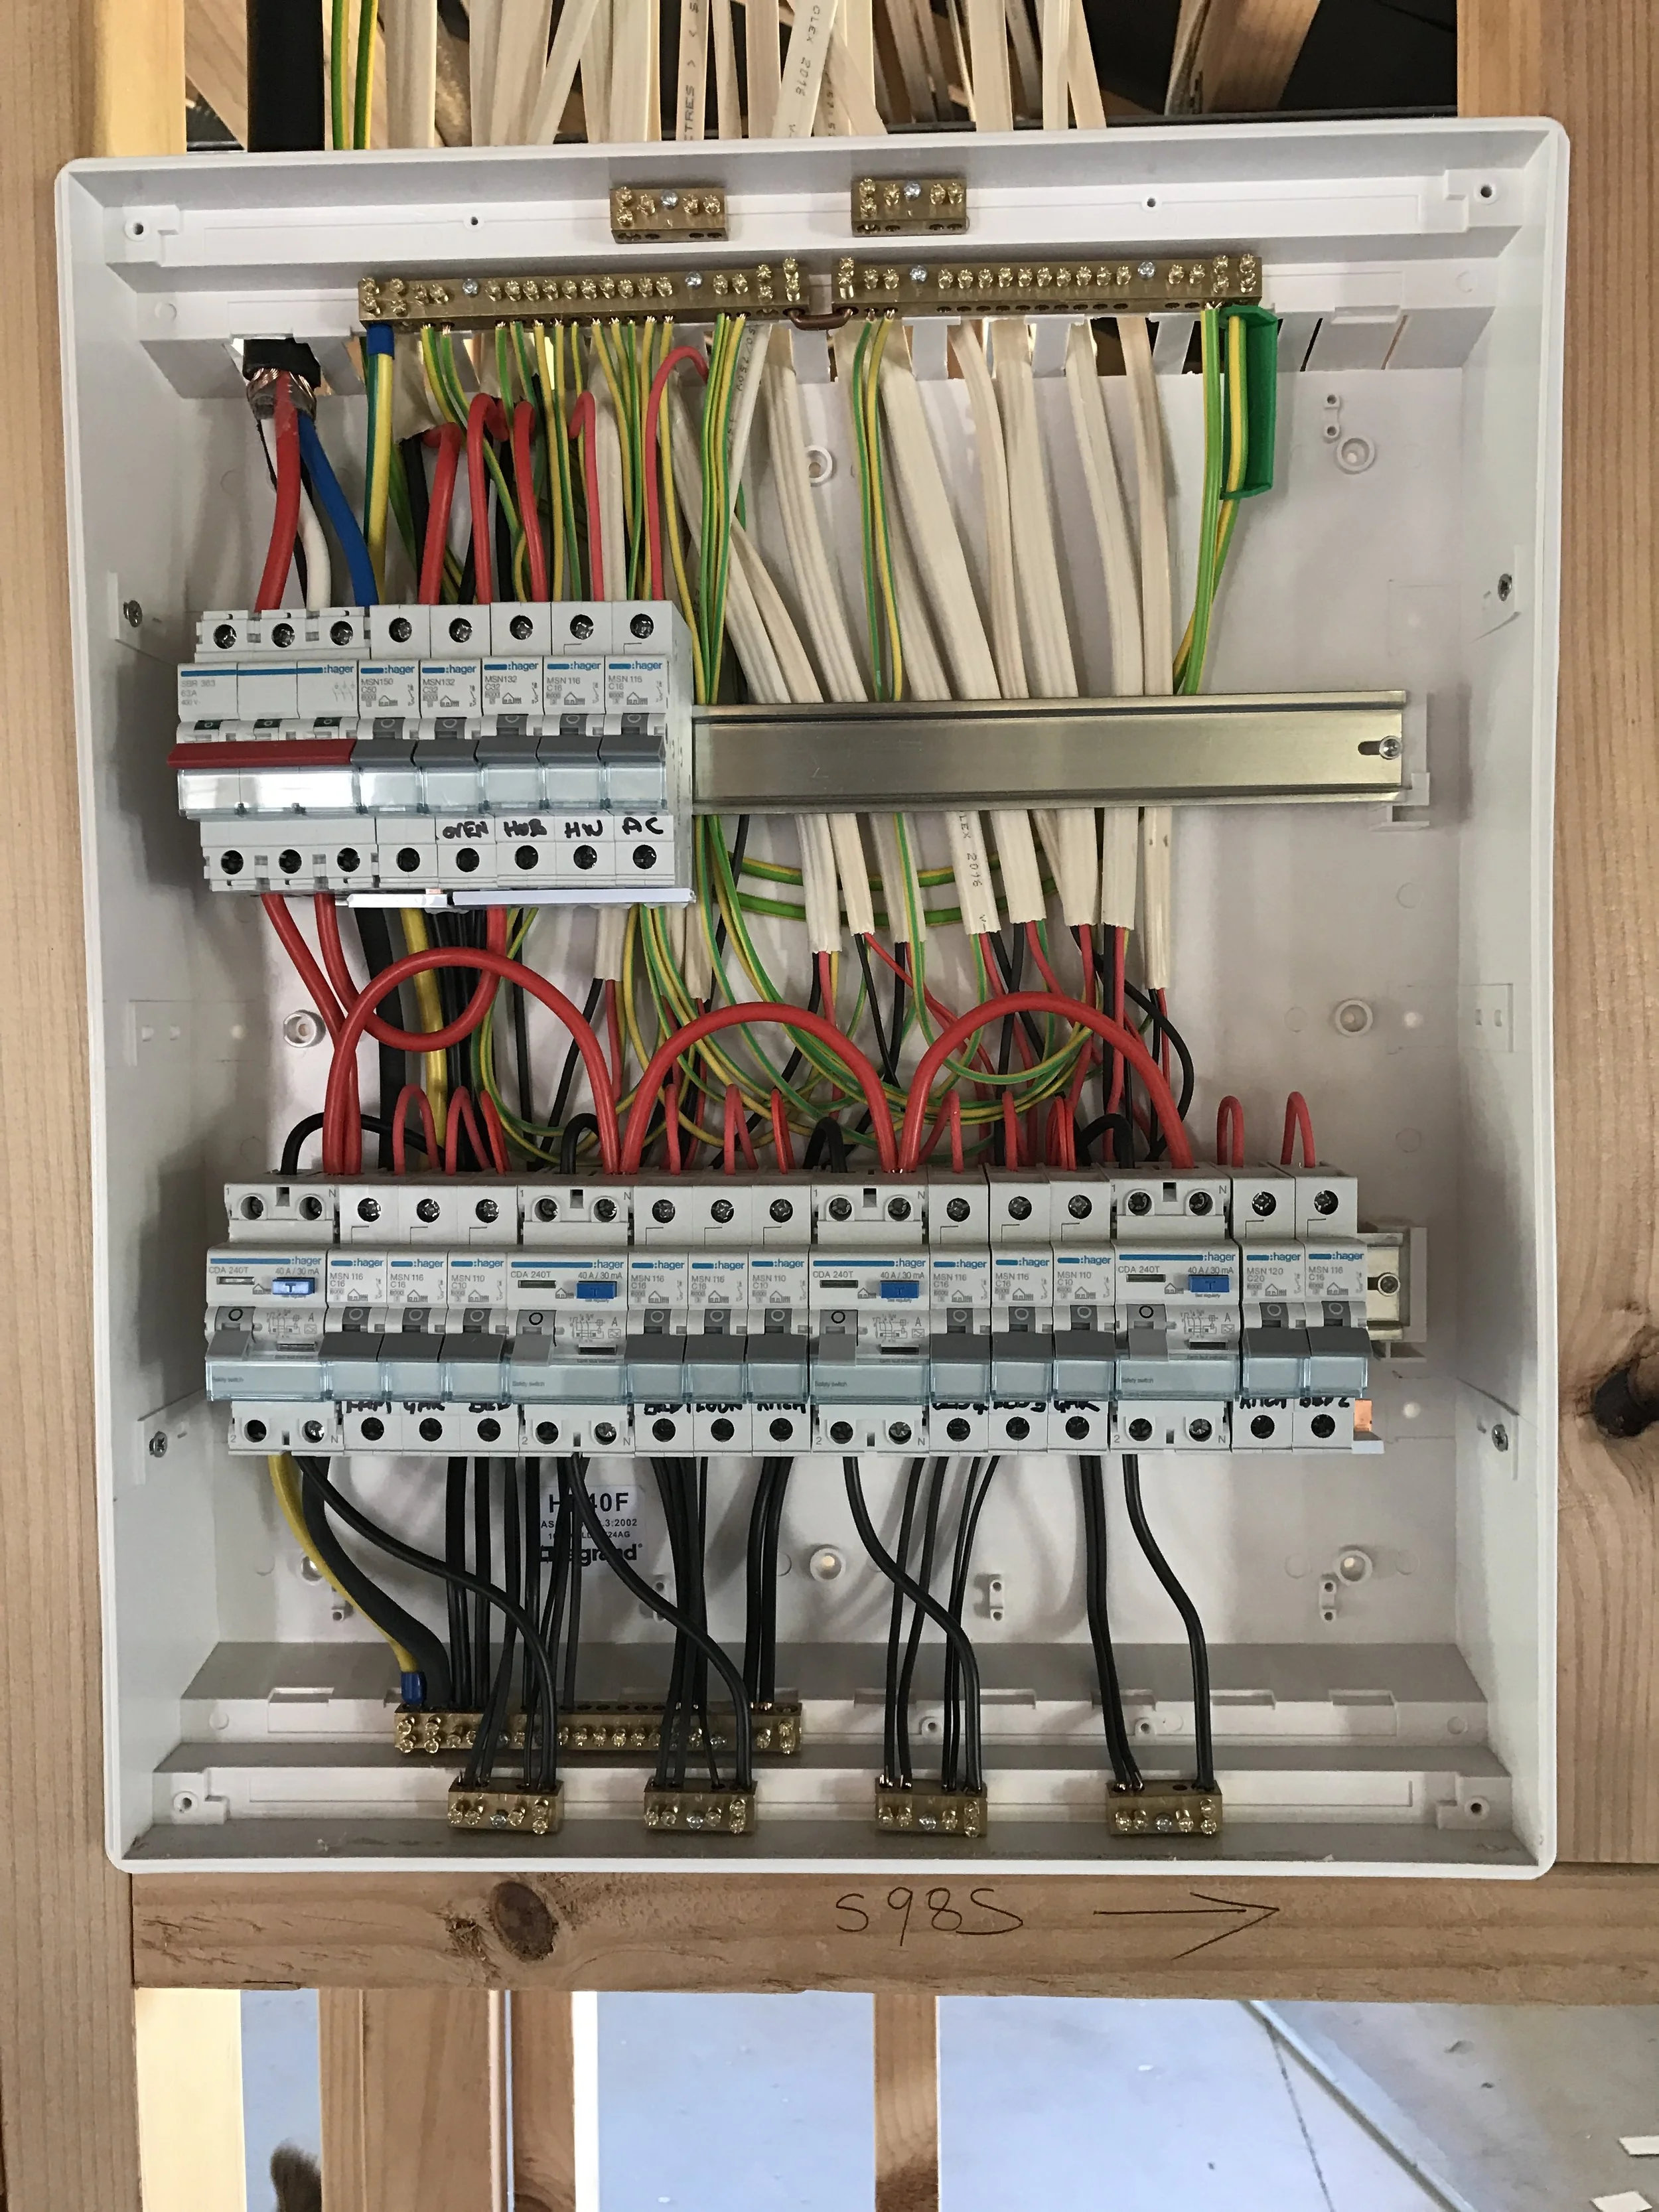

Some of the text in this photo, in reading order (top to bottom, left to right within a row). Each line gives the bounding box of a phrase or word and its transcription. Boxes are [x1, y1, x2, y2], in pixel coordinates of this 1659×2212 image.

[796, 5, 820, 96] OLEX 2016
[442, 820, 489, 839] OVEN
[564, 819, 603, 838] HW
[622, 816, 664, 835] AC
[959, 811, 983, 887] LEX 2016
[328, 1189, 336, 1198] N
[1218, 1185, 1226, 1194] N
[624, 1191, 632, 1200] N
[917, 1191, 925, 1199] N
[285, 1282, 297, 1293] T
[1205, 1280, 1216, 1290] T
[308, 1313, 315, 1322] A
[611, 1317, 618, 1326] A
[914, 1317, 922, 1327] A
[1224, 1313, 1231, 1322] A
[331, 1435, 338, 1443] N
[623, 1438, 631, 1446] N
[816, 1436, 822, 1445] 2
[917, 1438, 925, 1446] N
[1114, 1435, 1120, 1443] 2
[1218, 1435, 1226, 1443] N
[549, 1493, 629, 1513] H40F
